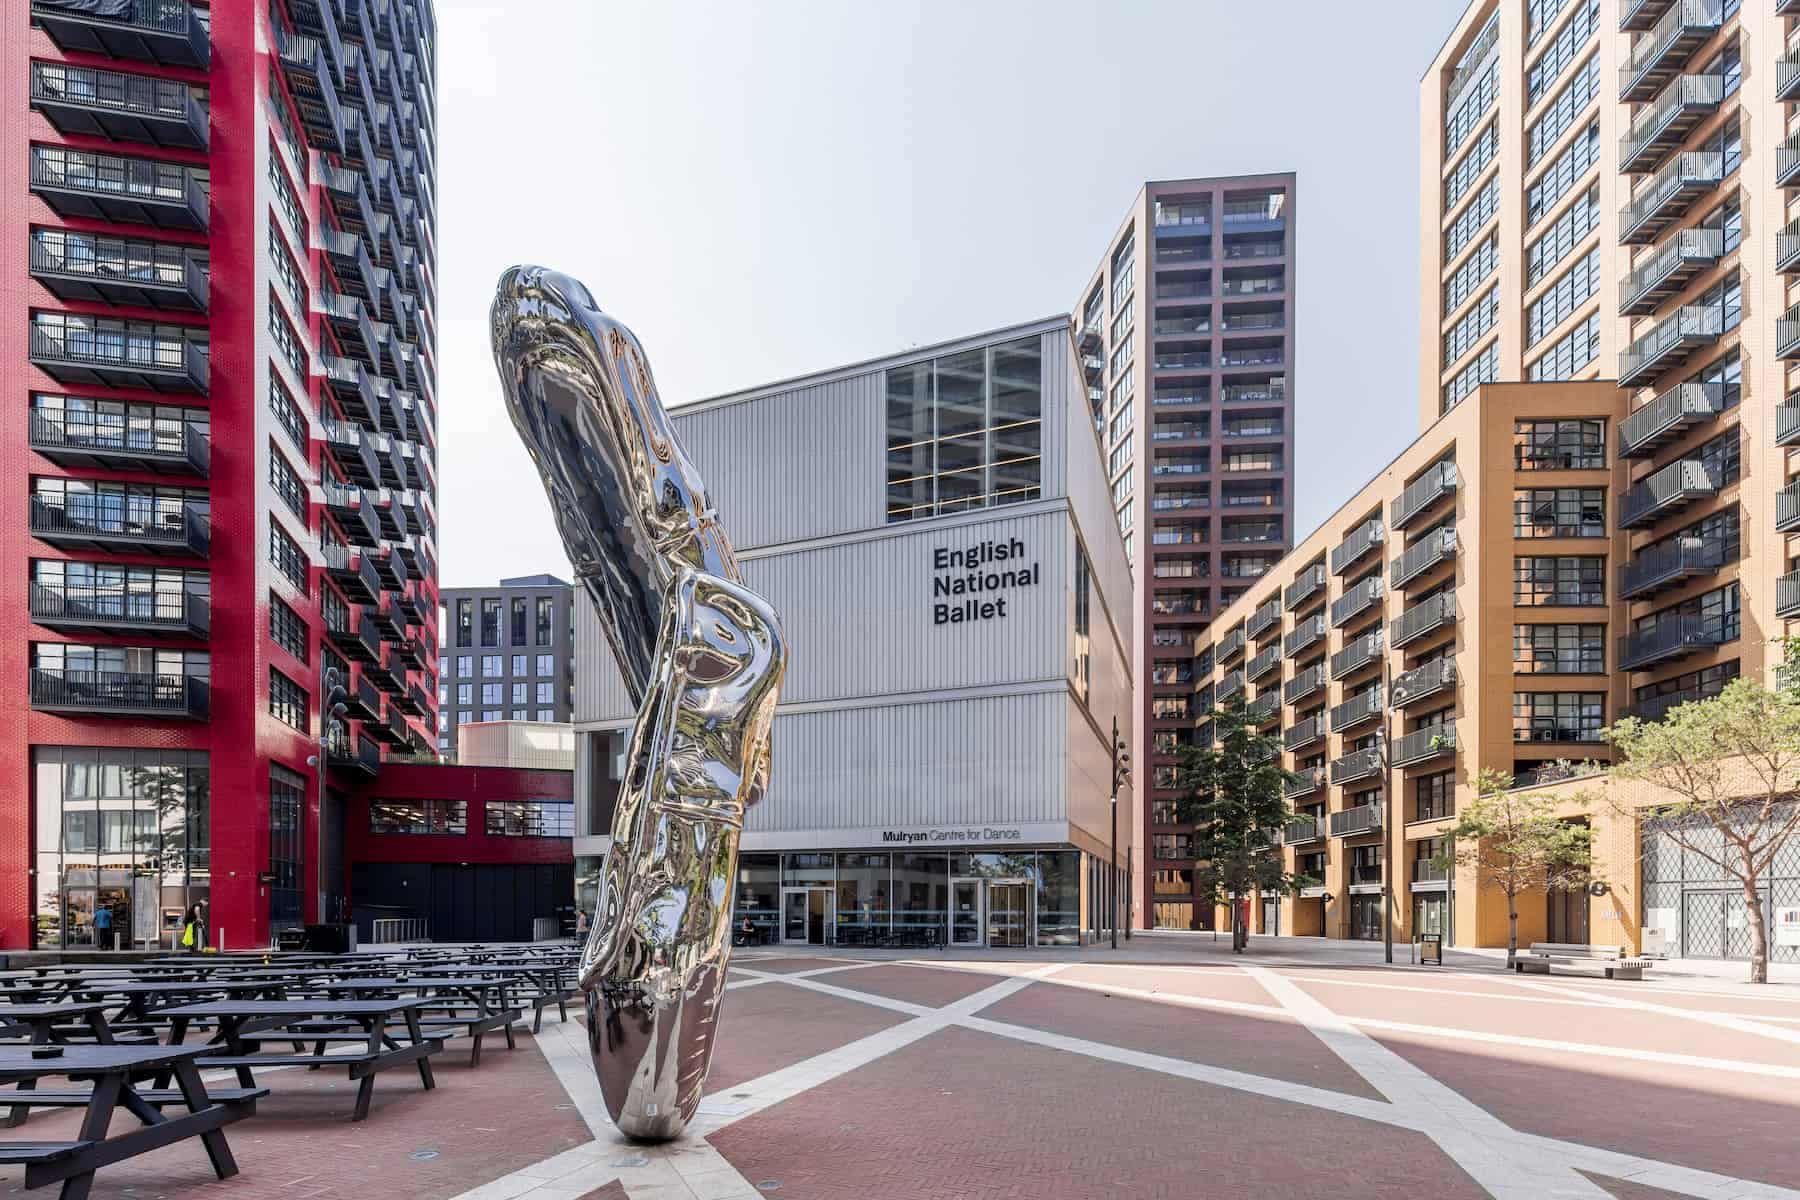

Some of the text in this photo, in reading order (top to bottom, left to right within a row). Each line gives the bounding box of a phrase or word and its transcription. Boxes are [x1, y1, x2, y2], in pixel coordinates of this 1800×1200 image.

[934, 537, 1024, 570] English
[934, 562, 1039, 597] National
[934, 597, 1006, 625] Ballet
[882, 828, 1021, 844] Mulryan Centre for Dance
